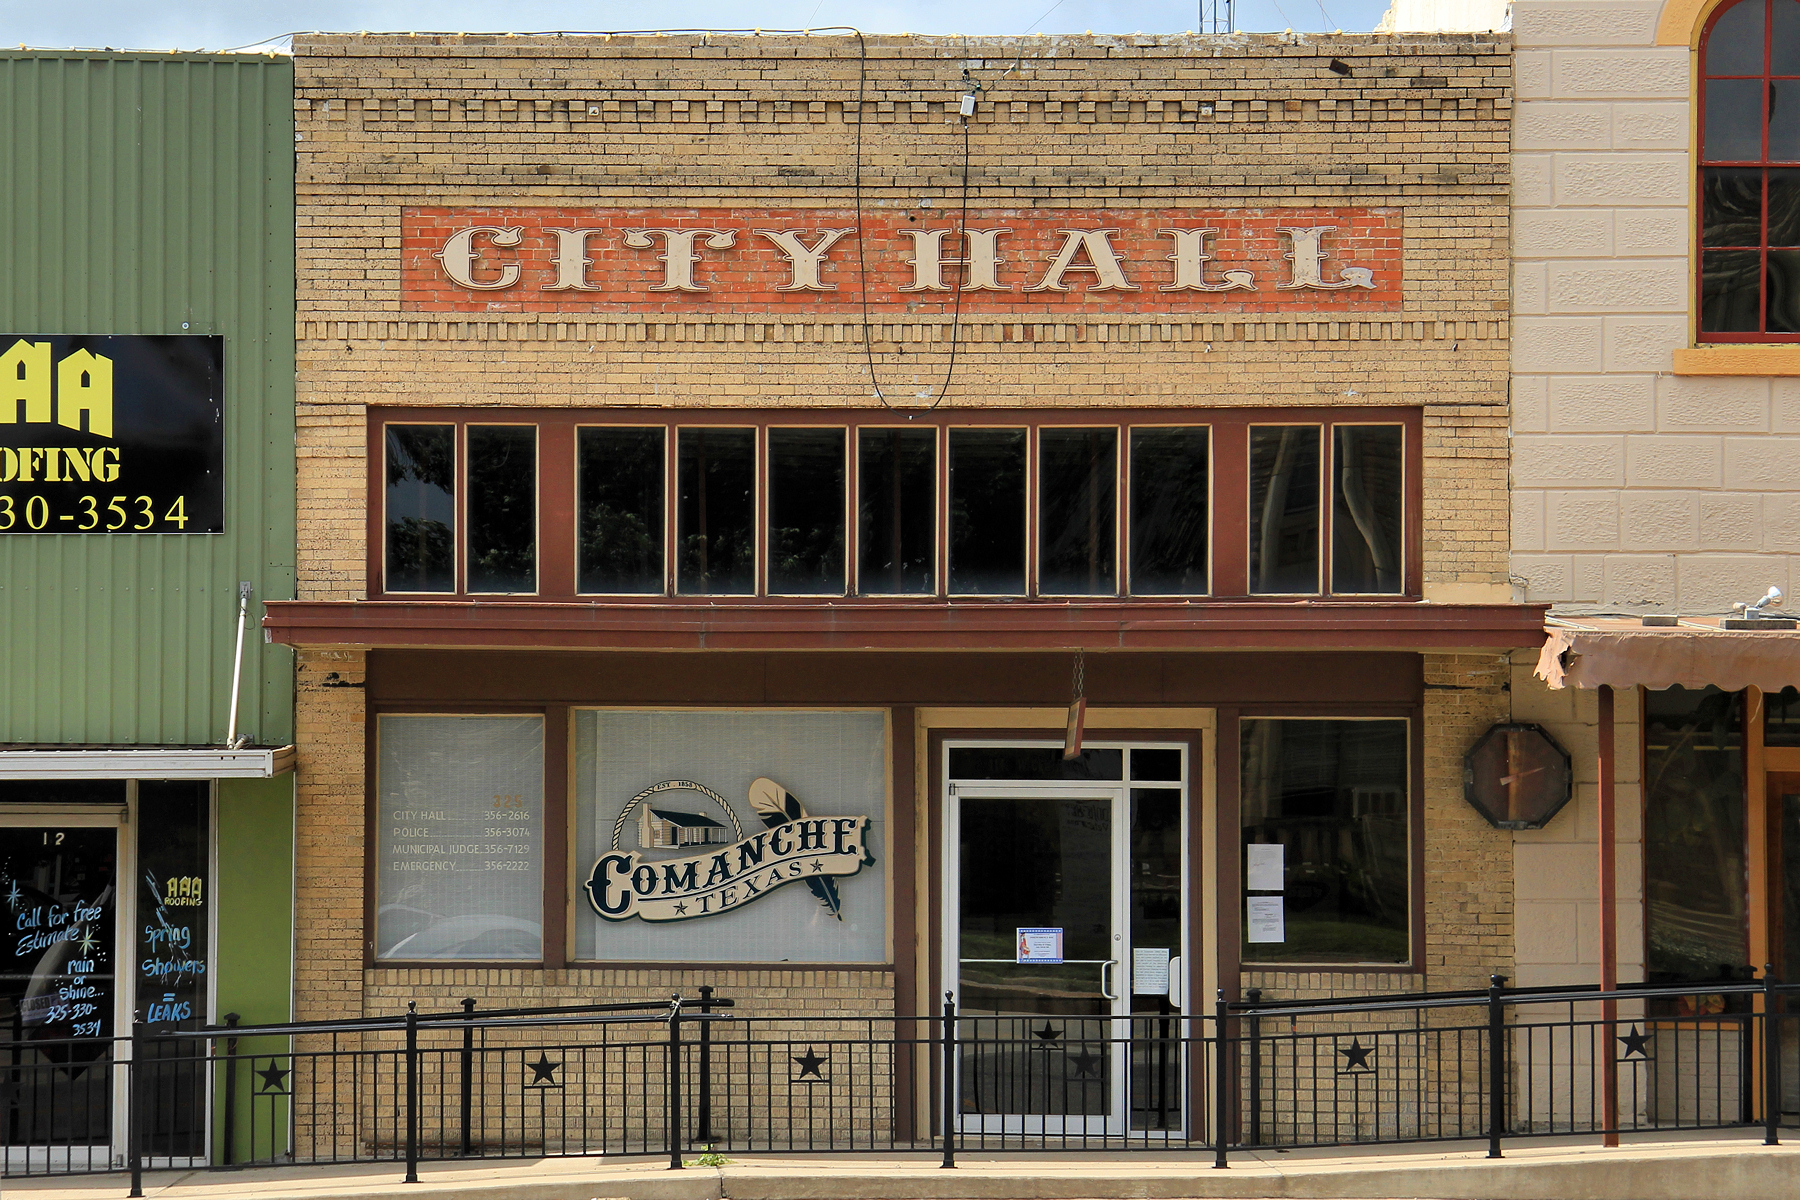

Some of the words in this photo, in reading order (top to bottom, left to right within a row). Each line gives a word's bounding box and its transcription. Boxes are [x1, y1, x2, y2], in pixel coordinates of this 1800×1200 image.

[432, 225, 857, 293] CITY
[897, 226, 1377, 293] HALL
[493, 795, 523, 808] 325
[393, 811, 418, 821] CITY
[420, 811, 446, 821] HALL
[484, 811, 530, 821] 356-2616
[393, 828, 429, 837] POLICE
[484, 828, 531, 837] 356-3074
[392, 844, 446, 854] MUNICIPAL
[449, 844, 480, 855] JUDGE
[484, 844, 530, 854] 356-7129
[393, 861, 457, 871] EMERGENCY
[484, 861, 530, 871] 356-2222
[588, 818, 858, 914] COMANCHE
[166, 876, 202, 899] AAA
[696, 861, 803, 913] TEXAS
[164, 897, 203, 906] ROOFING
[16, 906, 42, 930] Call
[48, 904, 69, 928] for
[73, 899, 102, 922] free
[15, 924, 80, 956] Estimate
[144, 924, 191, 953] Spring
[67, 956, 94, 975] rain
[142, 957, 206, 977] Showers
[73, 975, 87, 985] or
[44, 1003, 98, 1025] 325-330-
[147, 1001, 192, 1023] LEAKS
[72, 1019, 101, 1037] 3534
